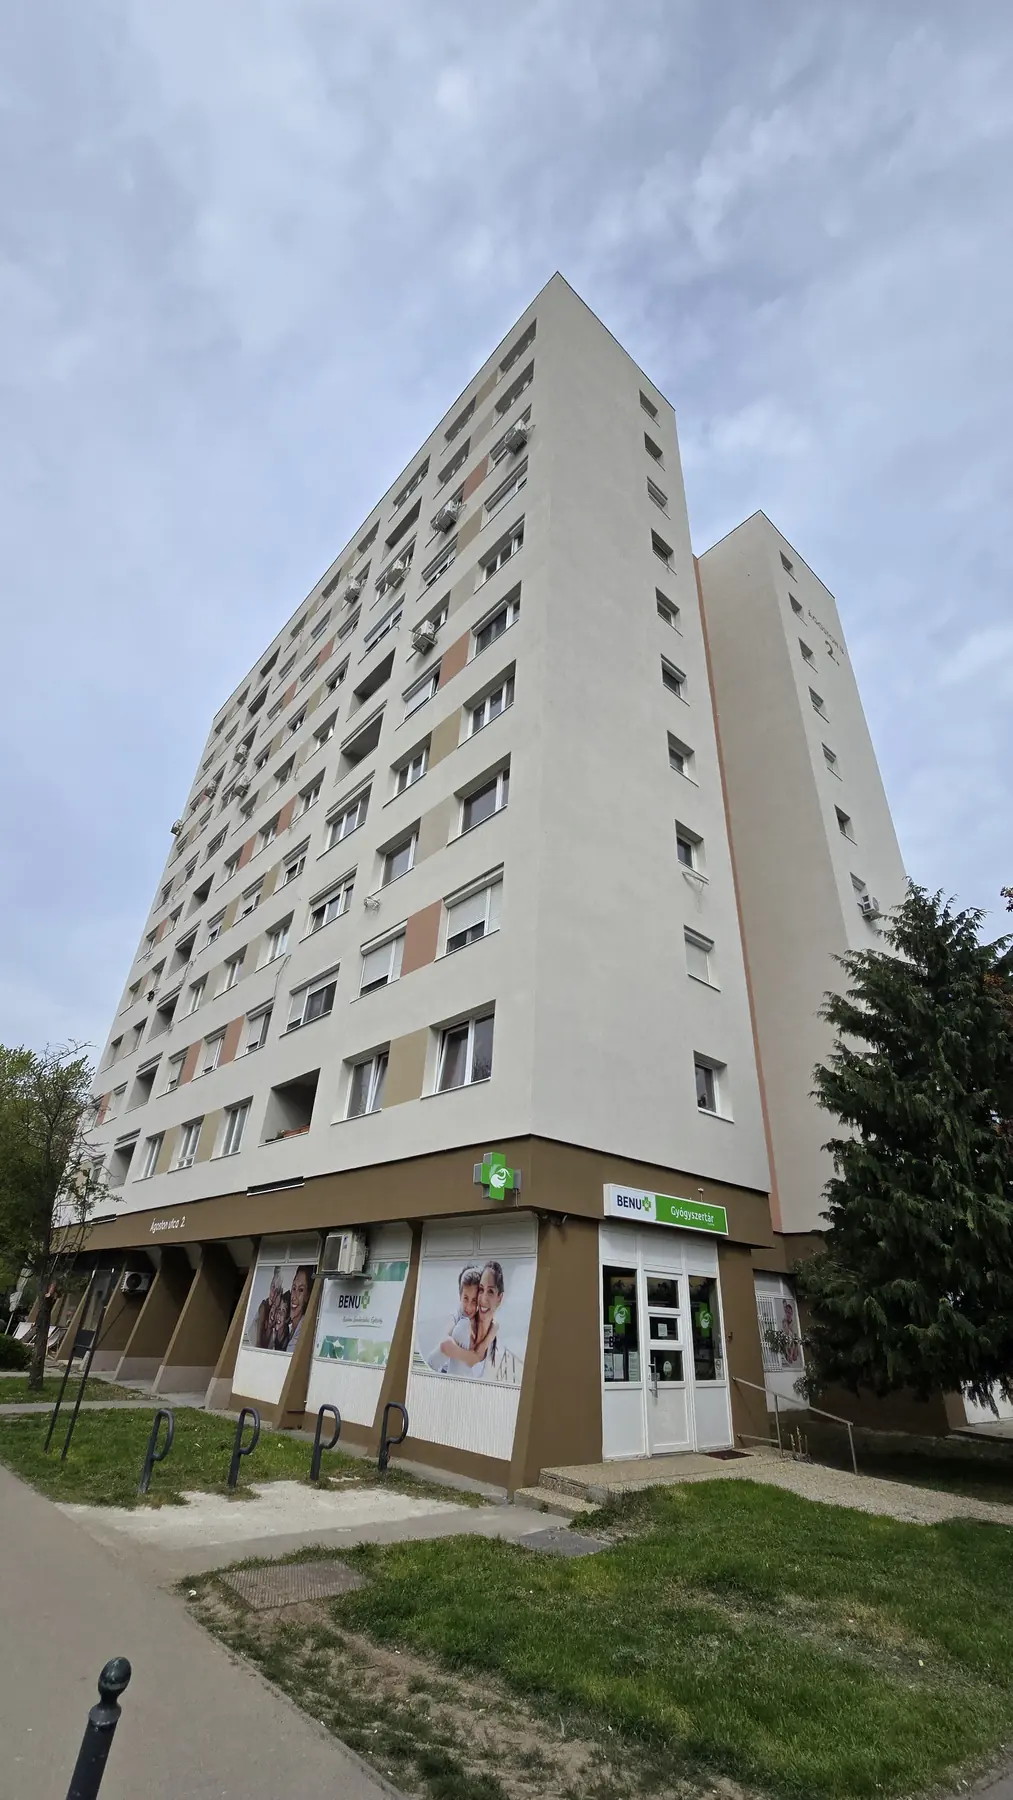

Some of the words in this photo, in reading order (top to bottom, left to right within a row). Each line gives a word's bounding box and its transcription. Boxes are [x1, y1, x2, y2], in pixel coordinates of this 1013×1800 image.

[616, 1194, 642, 1211] BENU
[670, 1205, 715, 1223] Gyógyszertár
[338, 1294, 361, 1309] BENU
